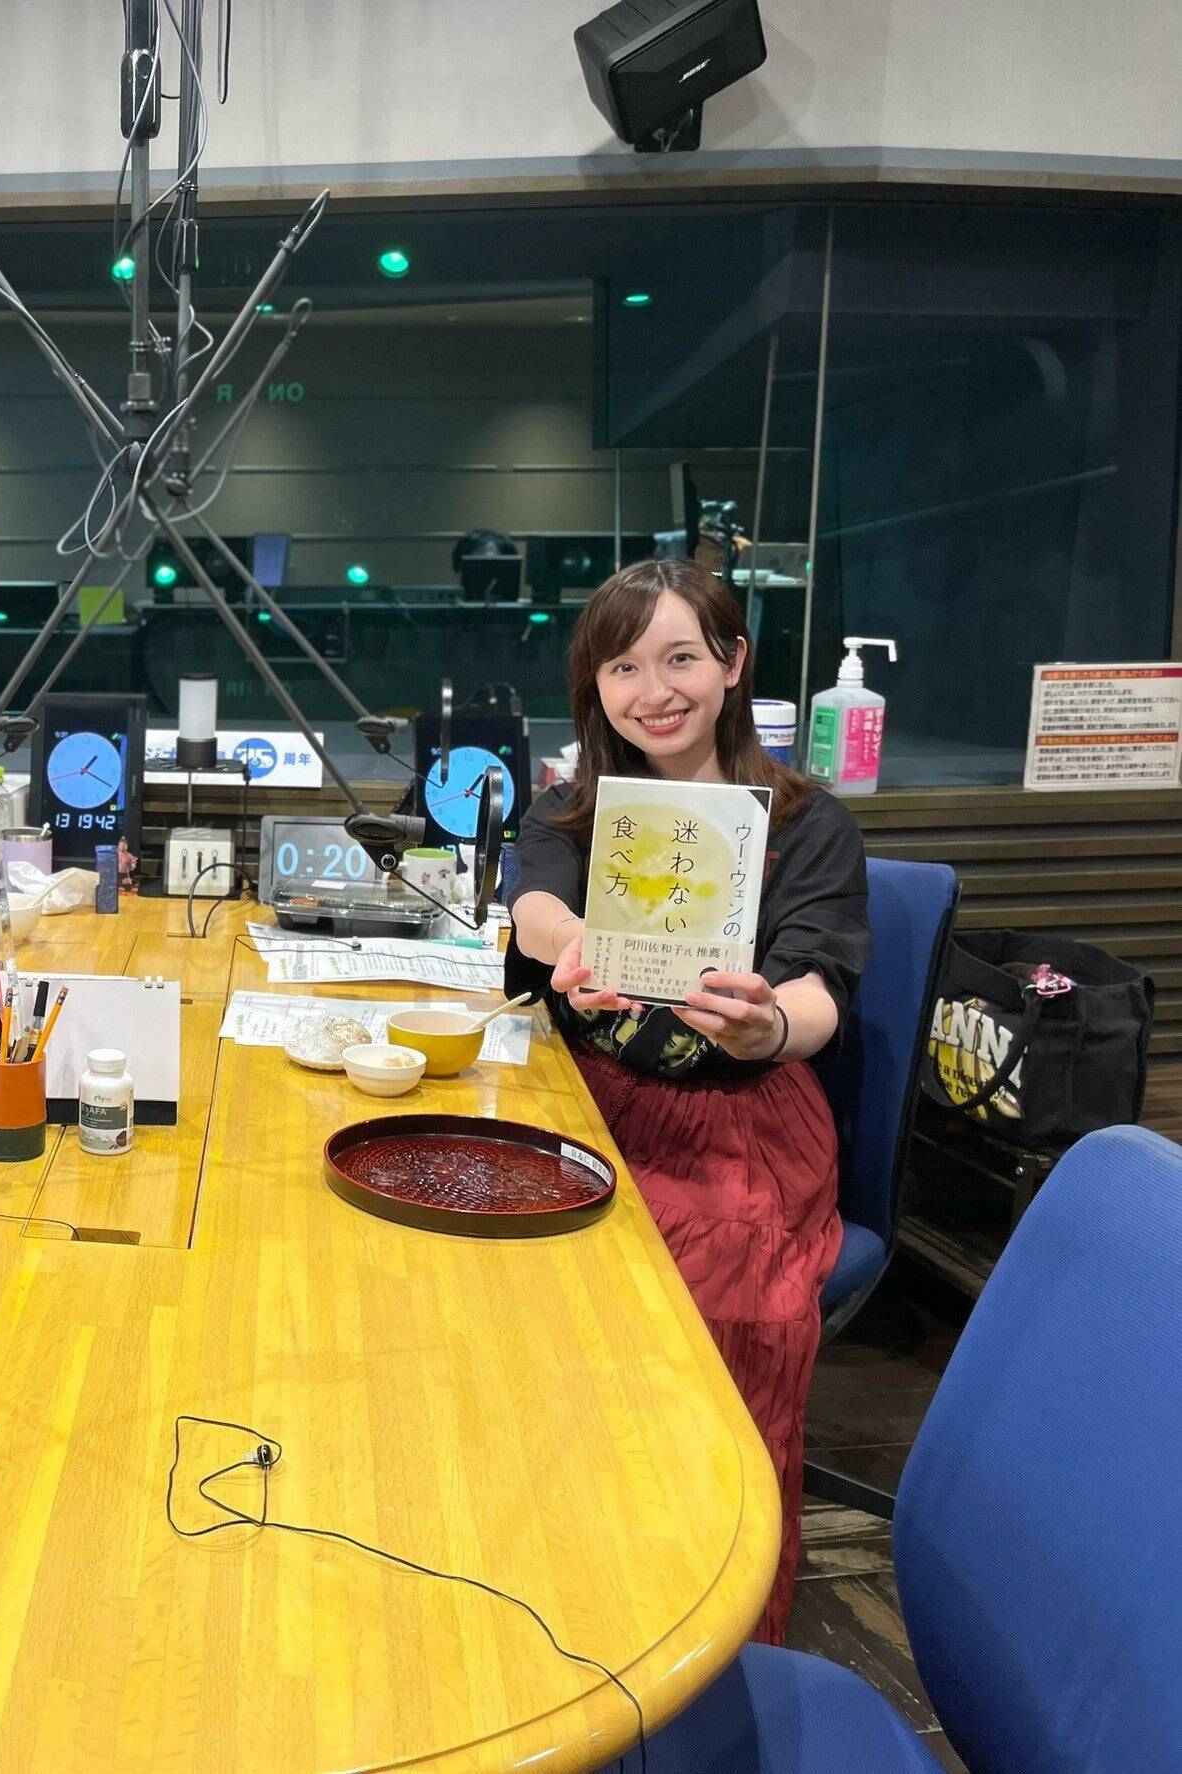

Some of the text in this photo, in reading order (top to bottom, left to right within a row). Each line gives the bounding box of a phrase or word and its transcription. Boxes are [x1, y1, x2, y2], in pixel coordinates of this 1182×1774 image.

[284, 753, 312, 765] 周年
[55, 813, 116, 830] 13 19 42
[277, 842, 367, 880] 0:20
[605, 814, 638, 897] 食べ方
[665, 819, 700, 934] 迷わない
[723, 822, 751, 938] ウー・ウェンの
